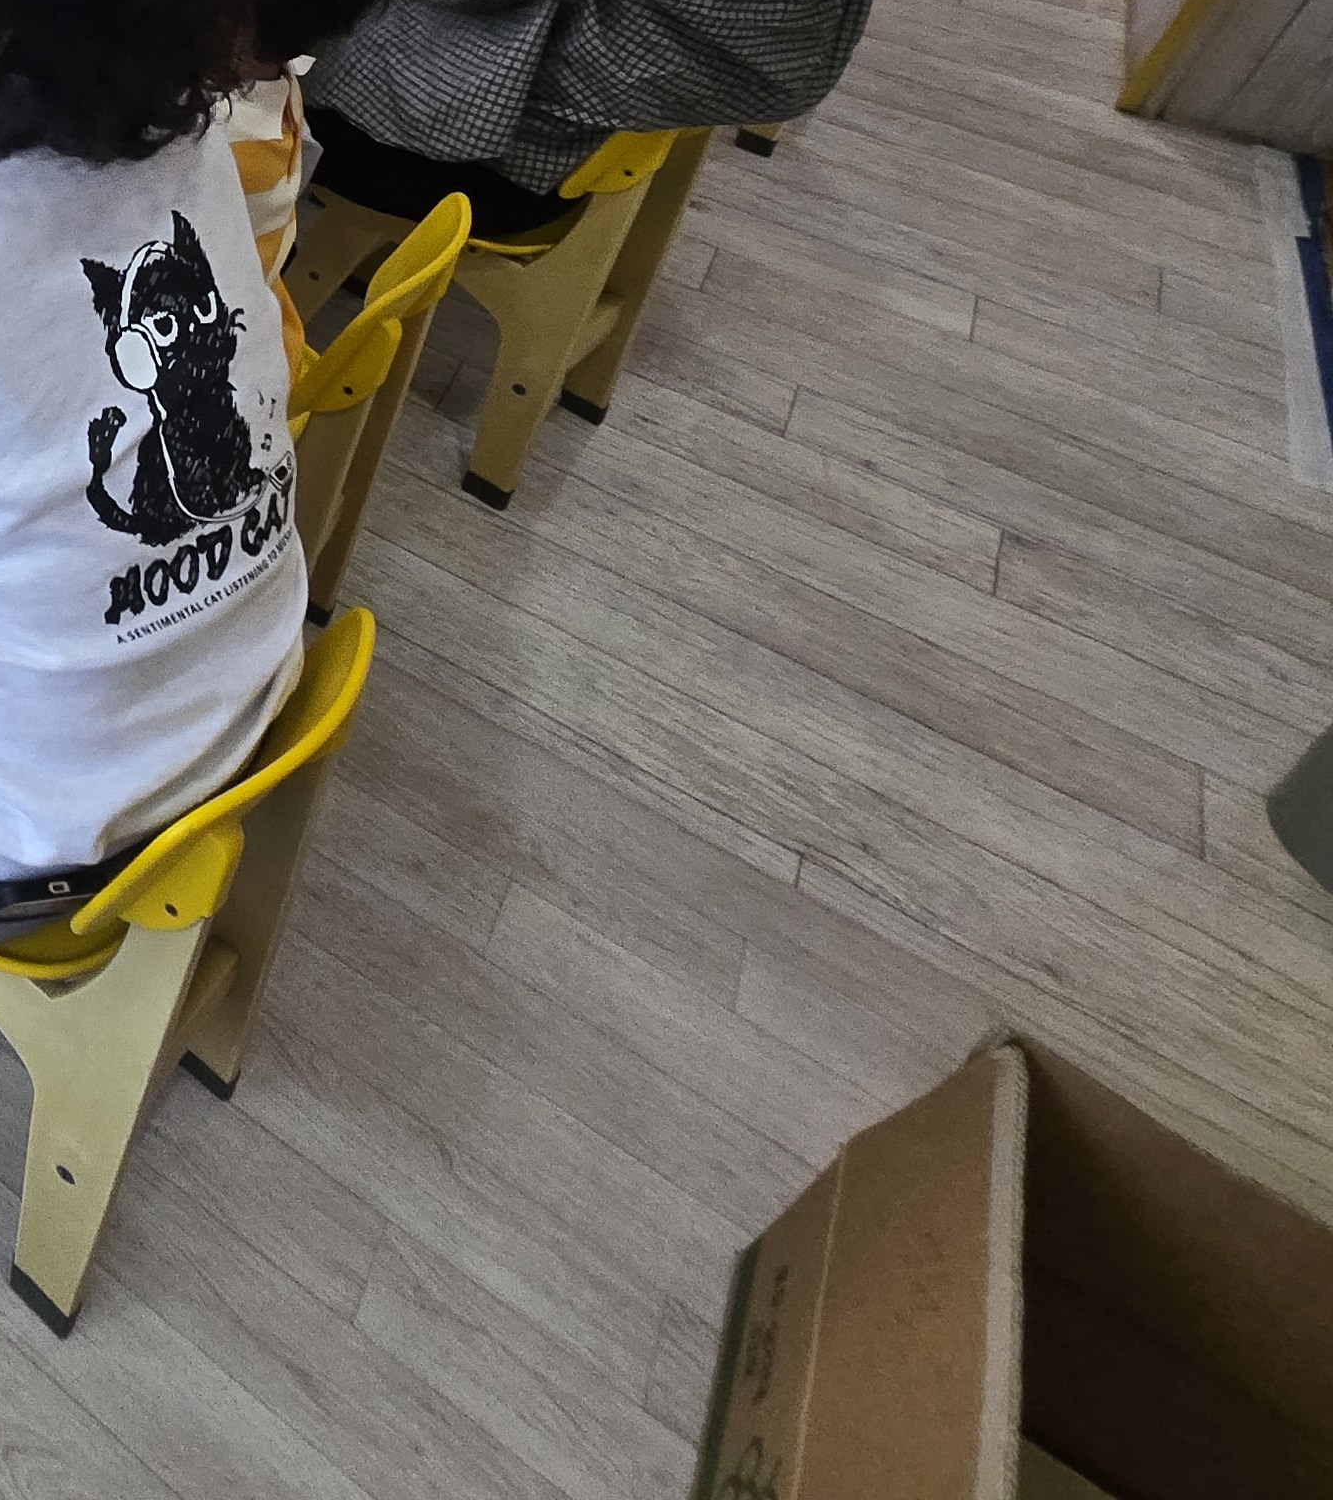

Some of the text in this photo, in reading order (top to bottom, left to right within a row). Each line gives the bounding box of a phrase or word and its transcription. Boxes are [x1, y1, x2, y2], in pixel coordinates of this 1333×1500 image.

[104, 524, 233, 625] MOOD
[116, 634, 127, 645] A
[127, 602, 204, 642] SENTIMENTAL
[204, 590, 224, 608] CAT
[223, 559, 269, 596] LISTENING
